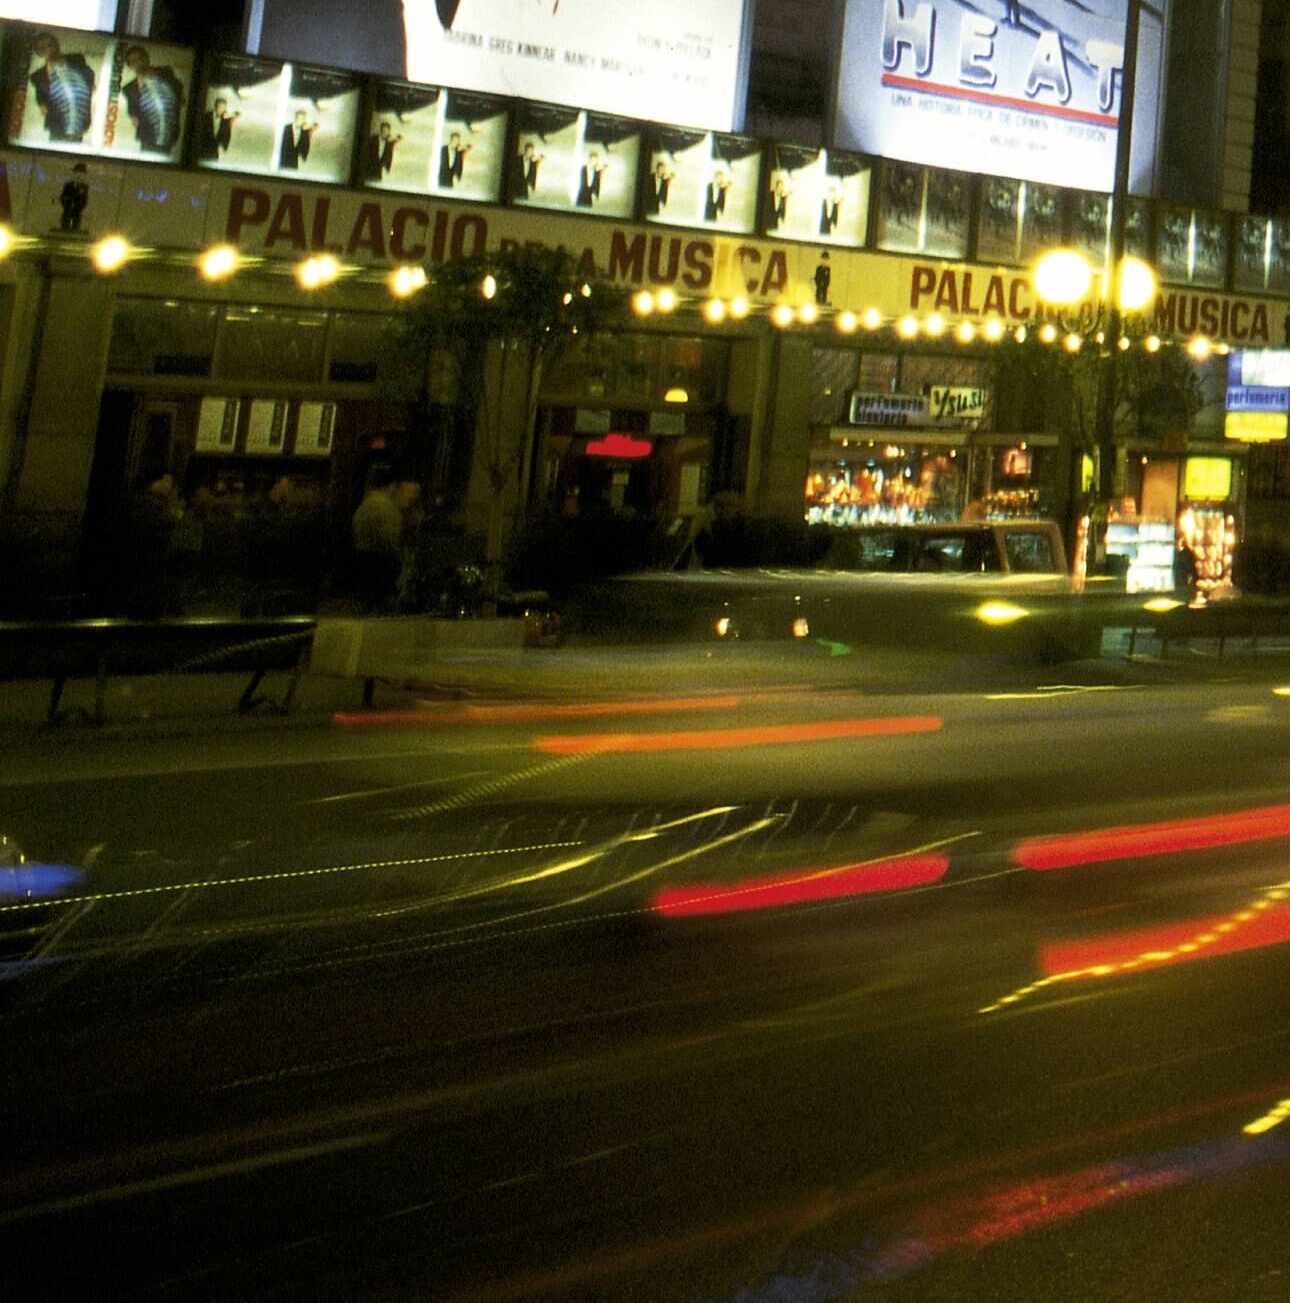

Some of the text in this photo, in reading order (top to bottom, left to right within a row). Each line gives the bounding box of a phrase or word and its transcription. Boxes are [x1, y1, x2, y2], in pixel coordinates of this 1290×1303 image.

[226, 186, 489, 265] PALACIO
[609, 229, 789, 295] MUSICA
[1152, 294, 1270, 343] MUSICA
